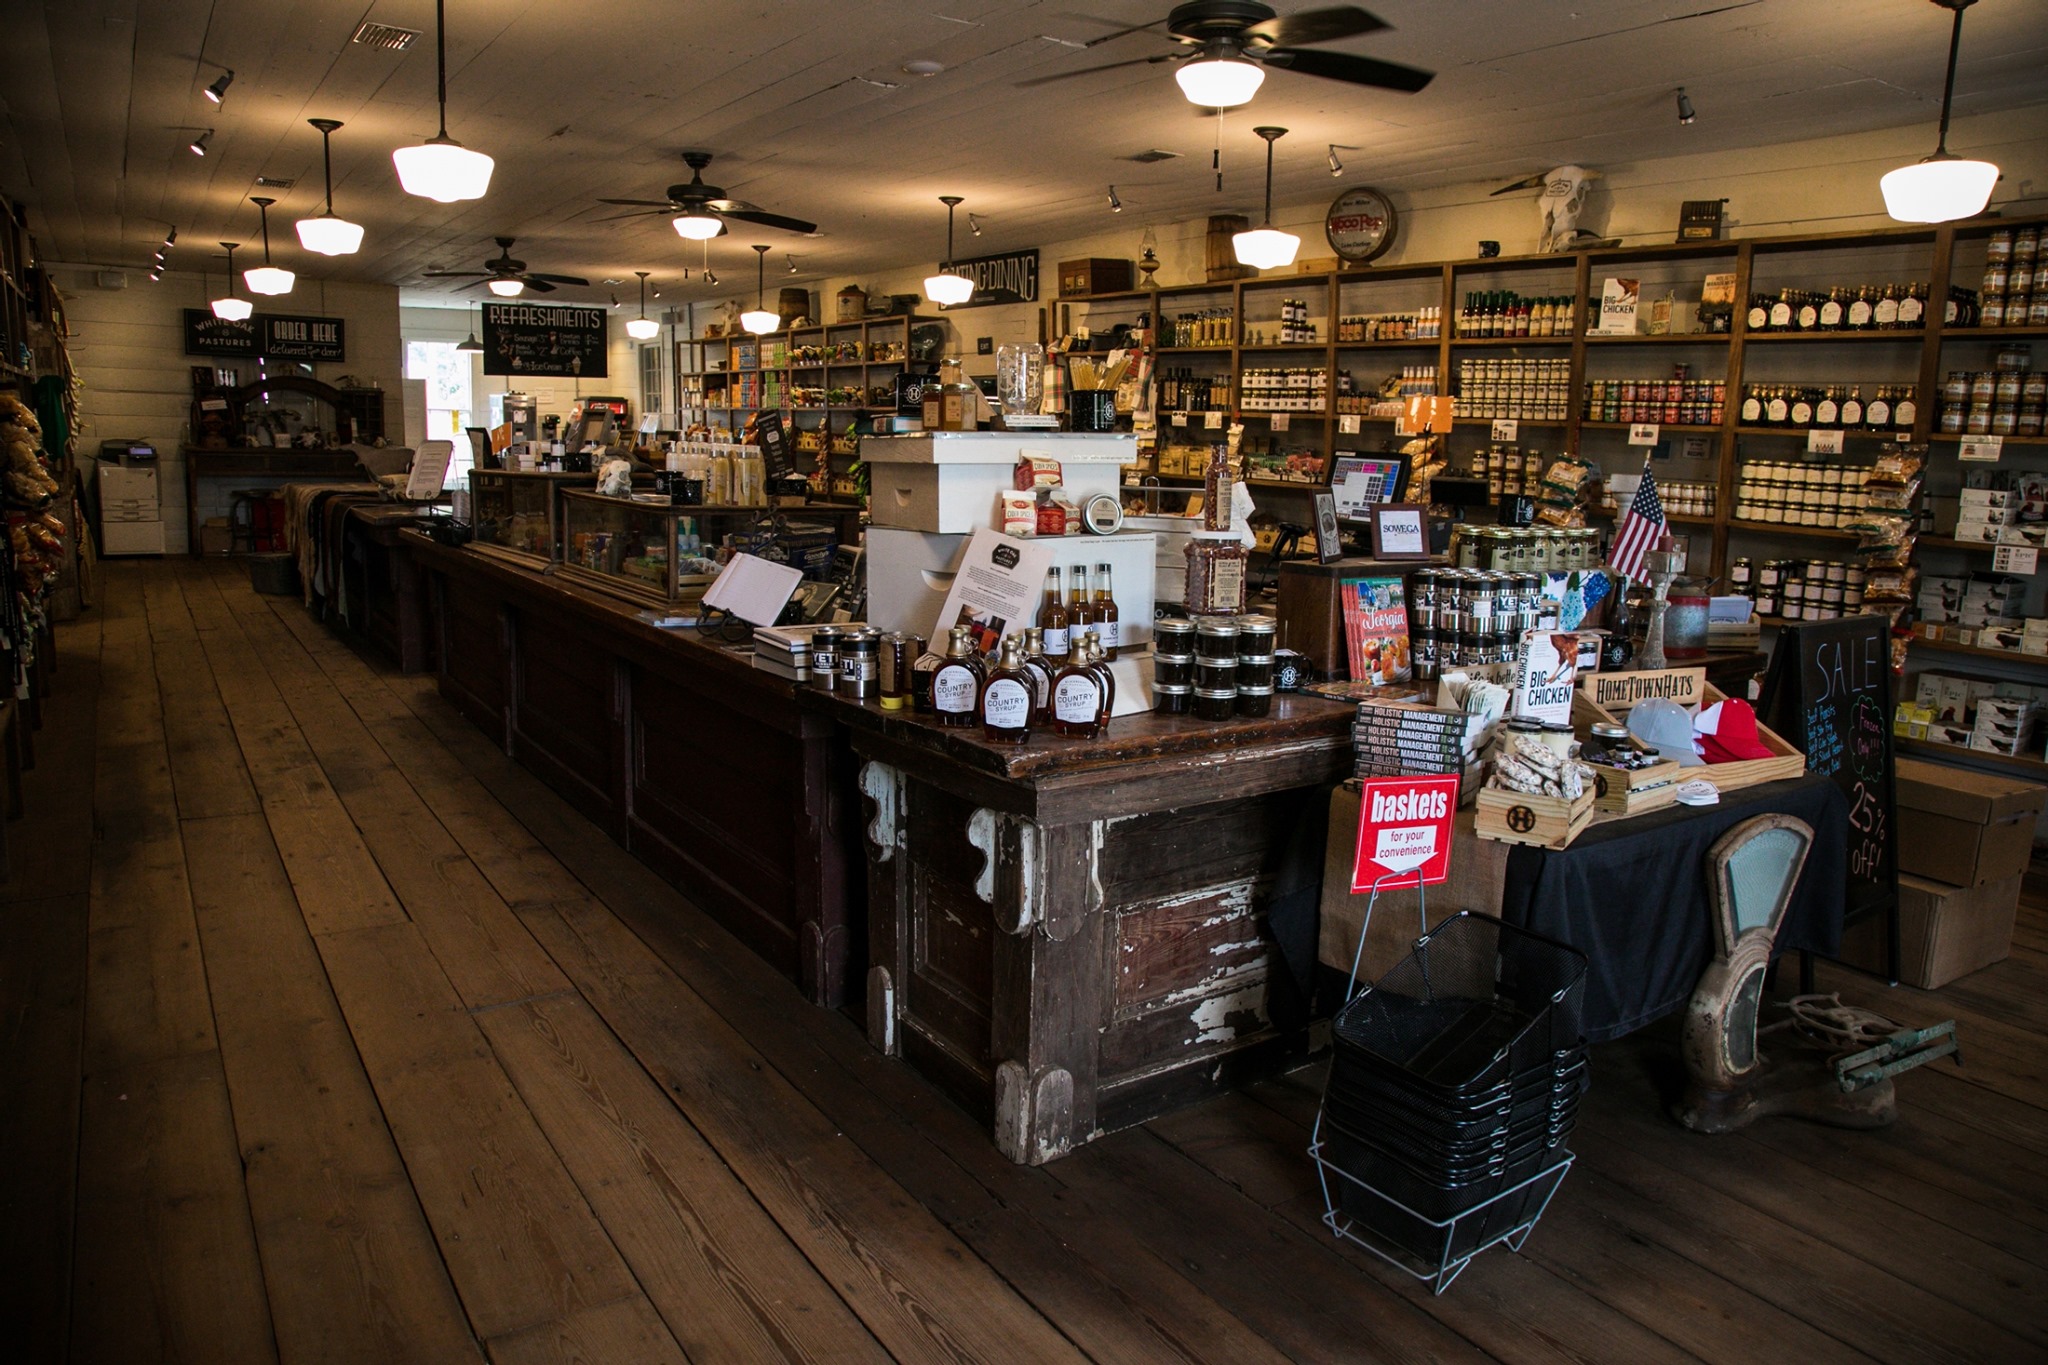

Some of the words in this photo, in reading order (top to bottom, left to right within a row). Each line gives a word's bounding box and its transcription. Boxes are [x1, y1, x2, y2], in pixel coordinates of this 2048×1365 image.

[988, 255, 1035, 301] DINING
[1604, 296, 1617, 304] BIG
[489, 304, 601, 329] REFRESHMENTS
[1602, 304, 1634, 314] CHICKEN
[232, 320, 255, 334] OAK
[273, 320, 307, 341] ORDER
[312, 323, 337, 342] HERE
[199, 337, 252, 347] PASTURES
[270, 343, 307, 355] delivered
[1383, 524, 1419, 533] SOWEGA
[1362, 608, 1405, 630] Georgia
[1519, 643, 1529, 656] BIG
[813, 652, 838, 663] YETI
[840, 659, 854, 669] ETI
[1497, 669, 1515, 685] bette
[1516, 657, 1528, 690] CHICKEN
[1816, 636, 1878, 703] SALE
[1530, 670, 1547, 688] BIG
[937, 682, 973, 694] COUNTRY
[944, 690, 965, 698] SYRUP
[987, 697, 1025, 707] COUNTRY
[1057, 693, 1094, 704] COUNTRY
[1528, 687, 1571, 706] CHICKEN
[1374, 708, 1402, 718] HOLISTIC
[1403, 711, 1447, 723] MANAGEMENT
[1372, 718, 1400, 728] HOLISTIC
[1401, 721, 1444, 733] MANAGEMENT
[1368, 726, 1396, 736] HOLISTIC
[1397, 730, 1440, 743] MANAGEMENT
[1367, 735, 1396, 746] HOLISTIC
[1397, 739, 1441, 752] MANAGEMENT
[1370, 746, 1400, 757] HOLISTIC
[1400, 749, 1444, 762] MANAGEMENT
[1373, 756, 1401, 766] HOLISTIC
[1401, 759, 1444, 772] MANAGEMENT
[1370, 789, 1448, 823] baskets
[1849, 781, 1886, 841] 25%
[1390, 831, 1403, 842] for
[1405, 831, 1425, 844] your
[1379, 845, 1432, 858] convenience
